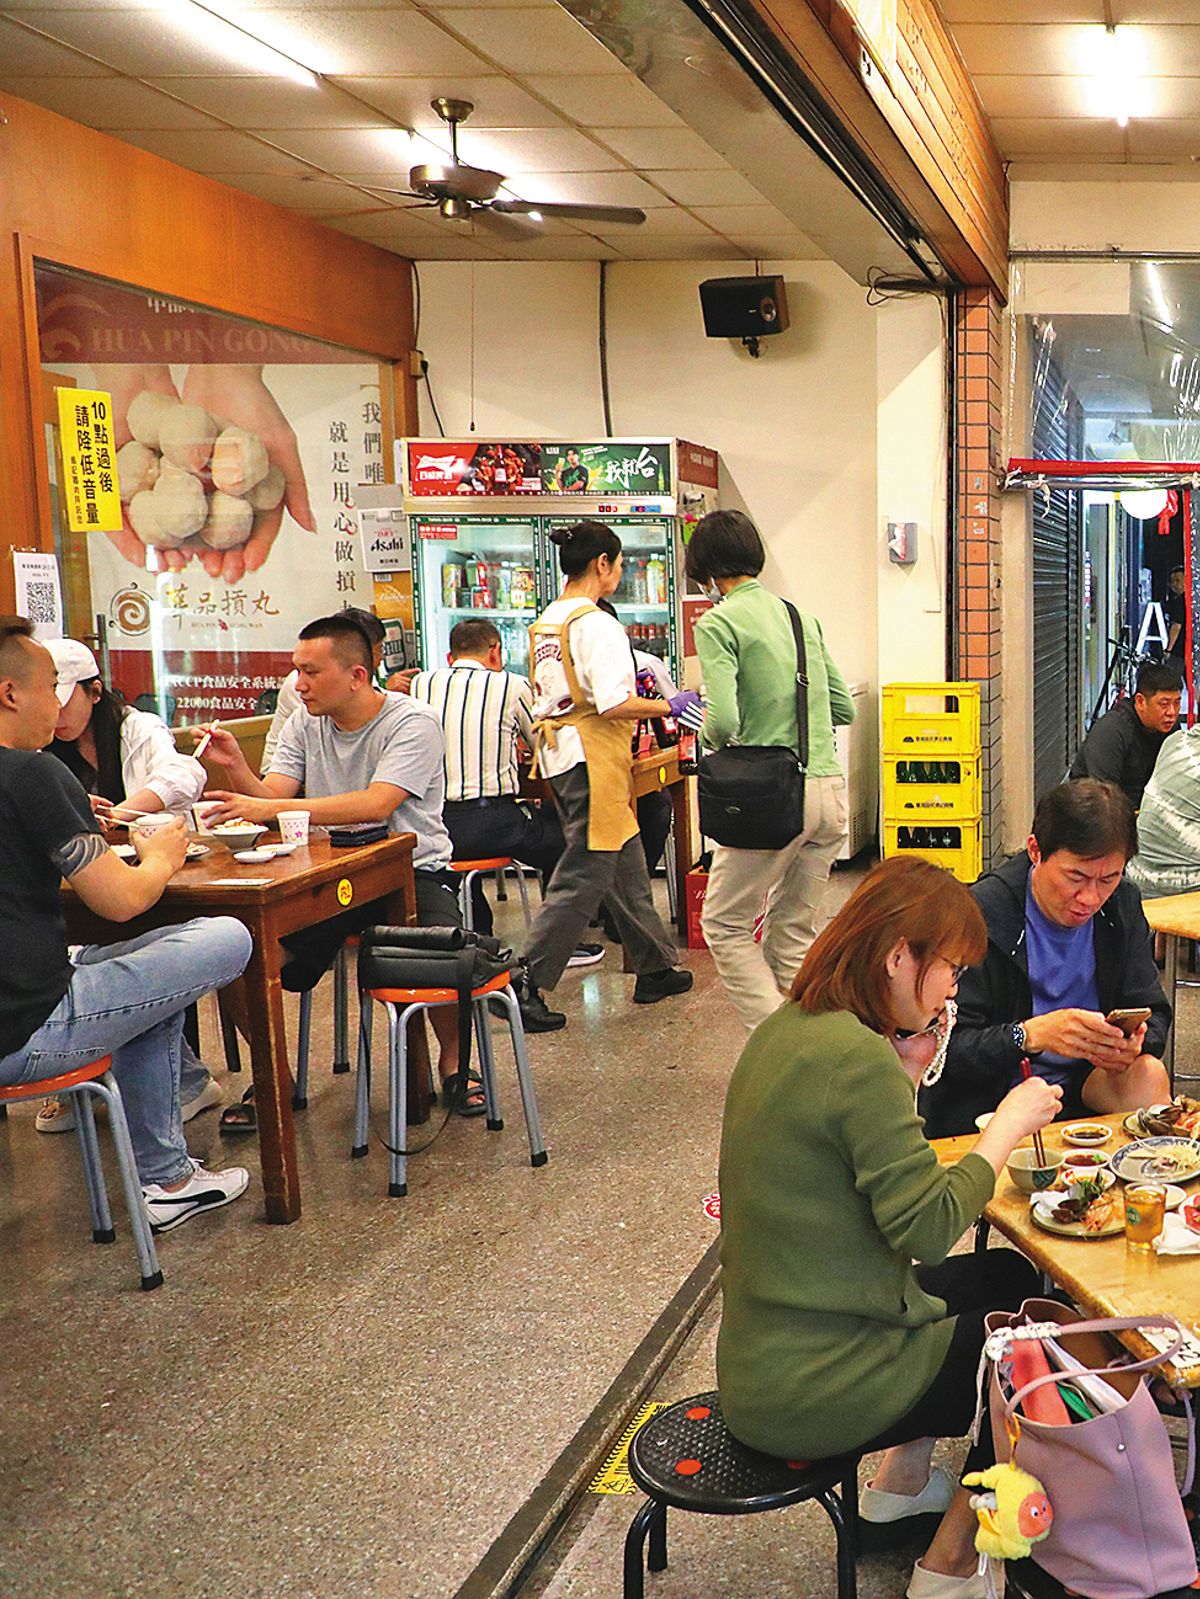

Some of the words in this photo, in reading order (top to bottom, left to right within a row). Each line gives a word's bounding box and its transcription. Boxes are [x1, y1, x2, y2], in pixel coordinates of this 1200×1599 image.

[75, 405, 99, 524] 請降低音量
[91, 401, 113, 492] 10點過後
[330, 420, 357, 613] 就是用心做摃
[371, 537, 404, 552] Asahi
